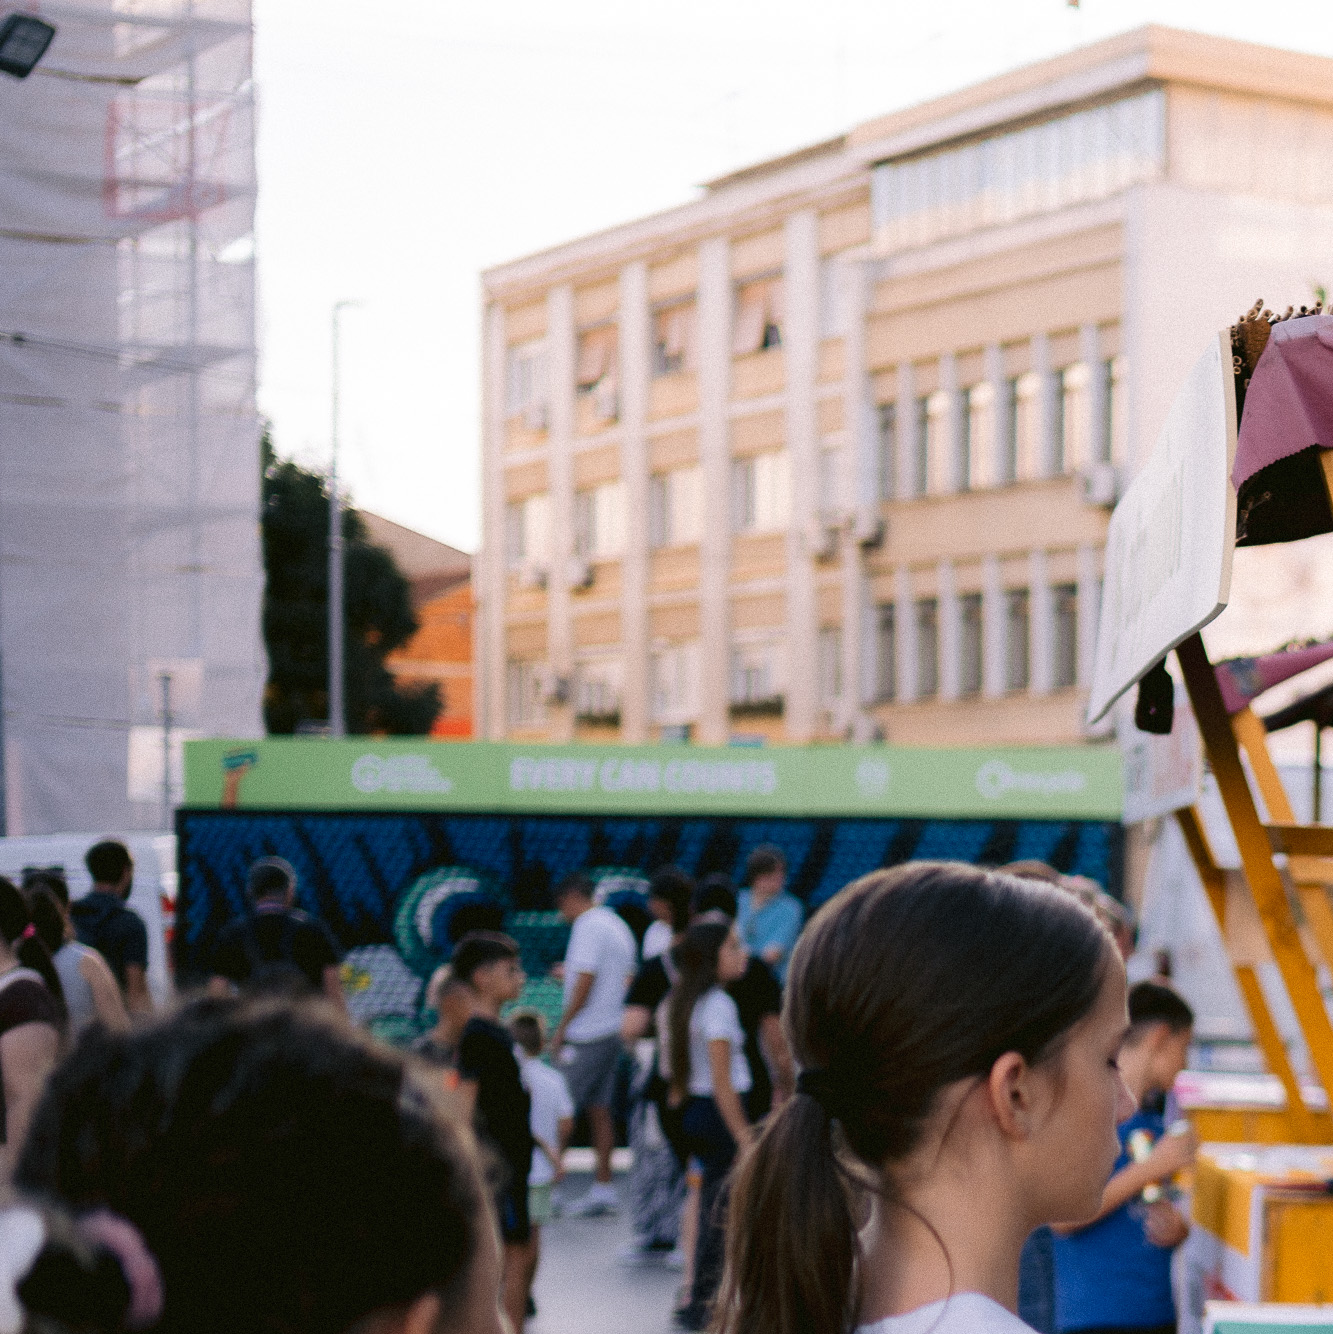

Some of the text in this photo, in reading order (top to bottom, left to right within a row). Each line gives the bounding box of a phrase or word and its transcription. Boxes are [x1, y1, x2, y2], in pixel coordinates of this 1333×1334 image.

[509, 757, 778, 794] EVERY CAN COUNTS
